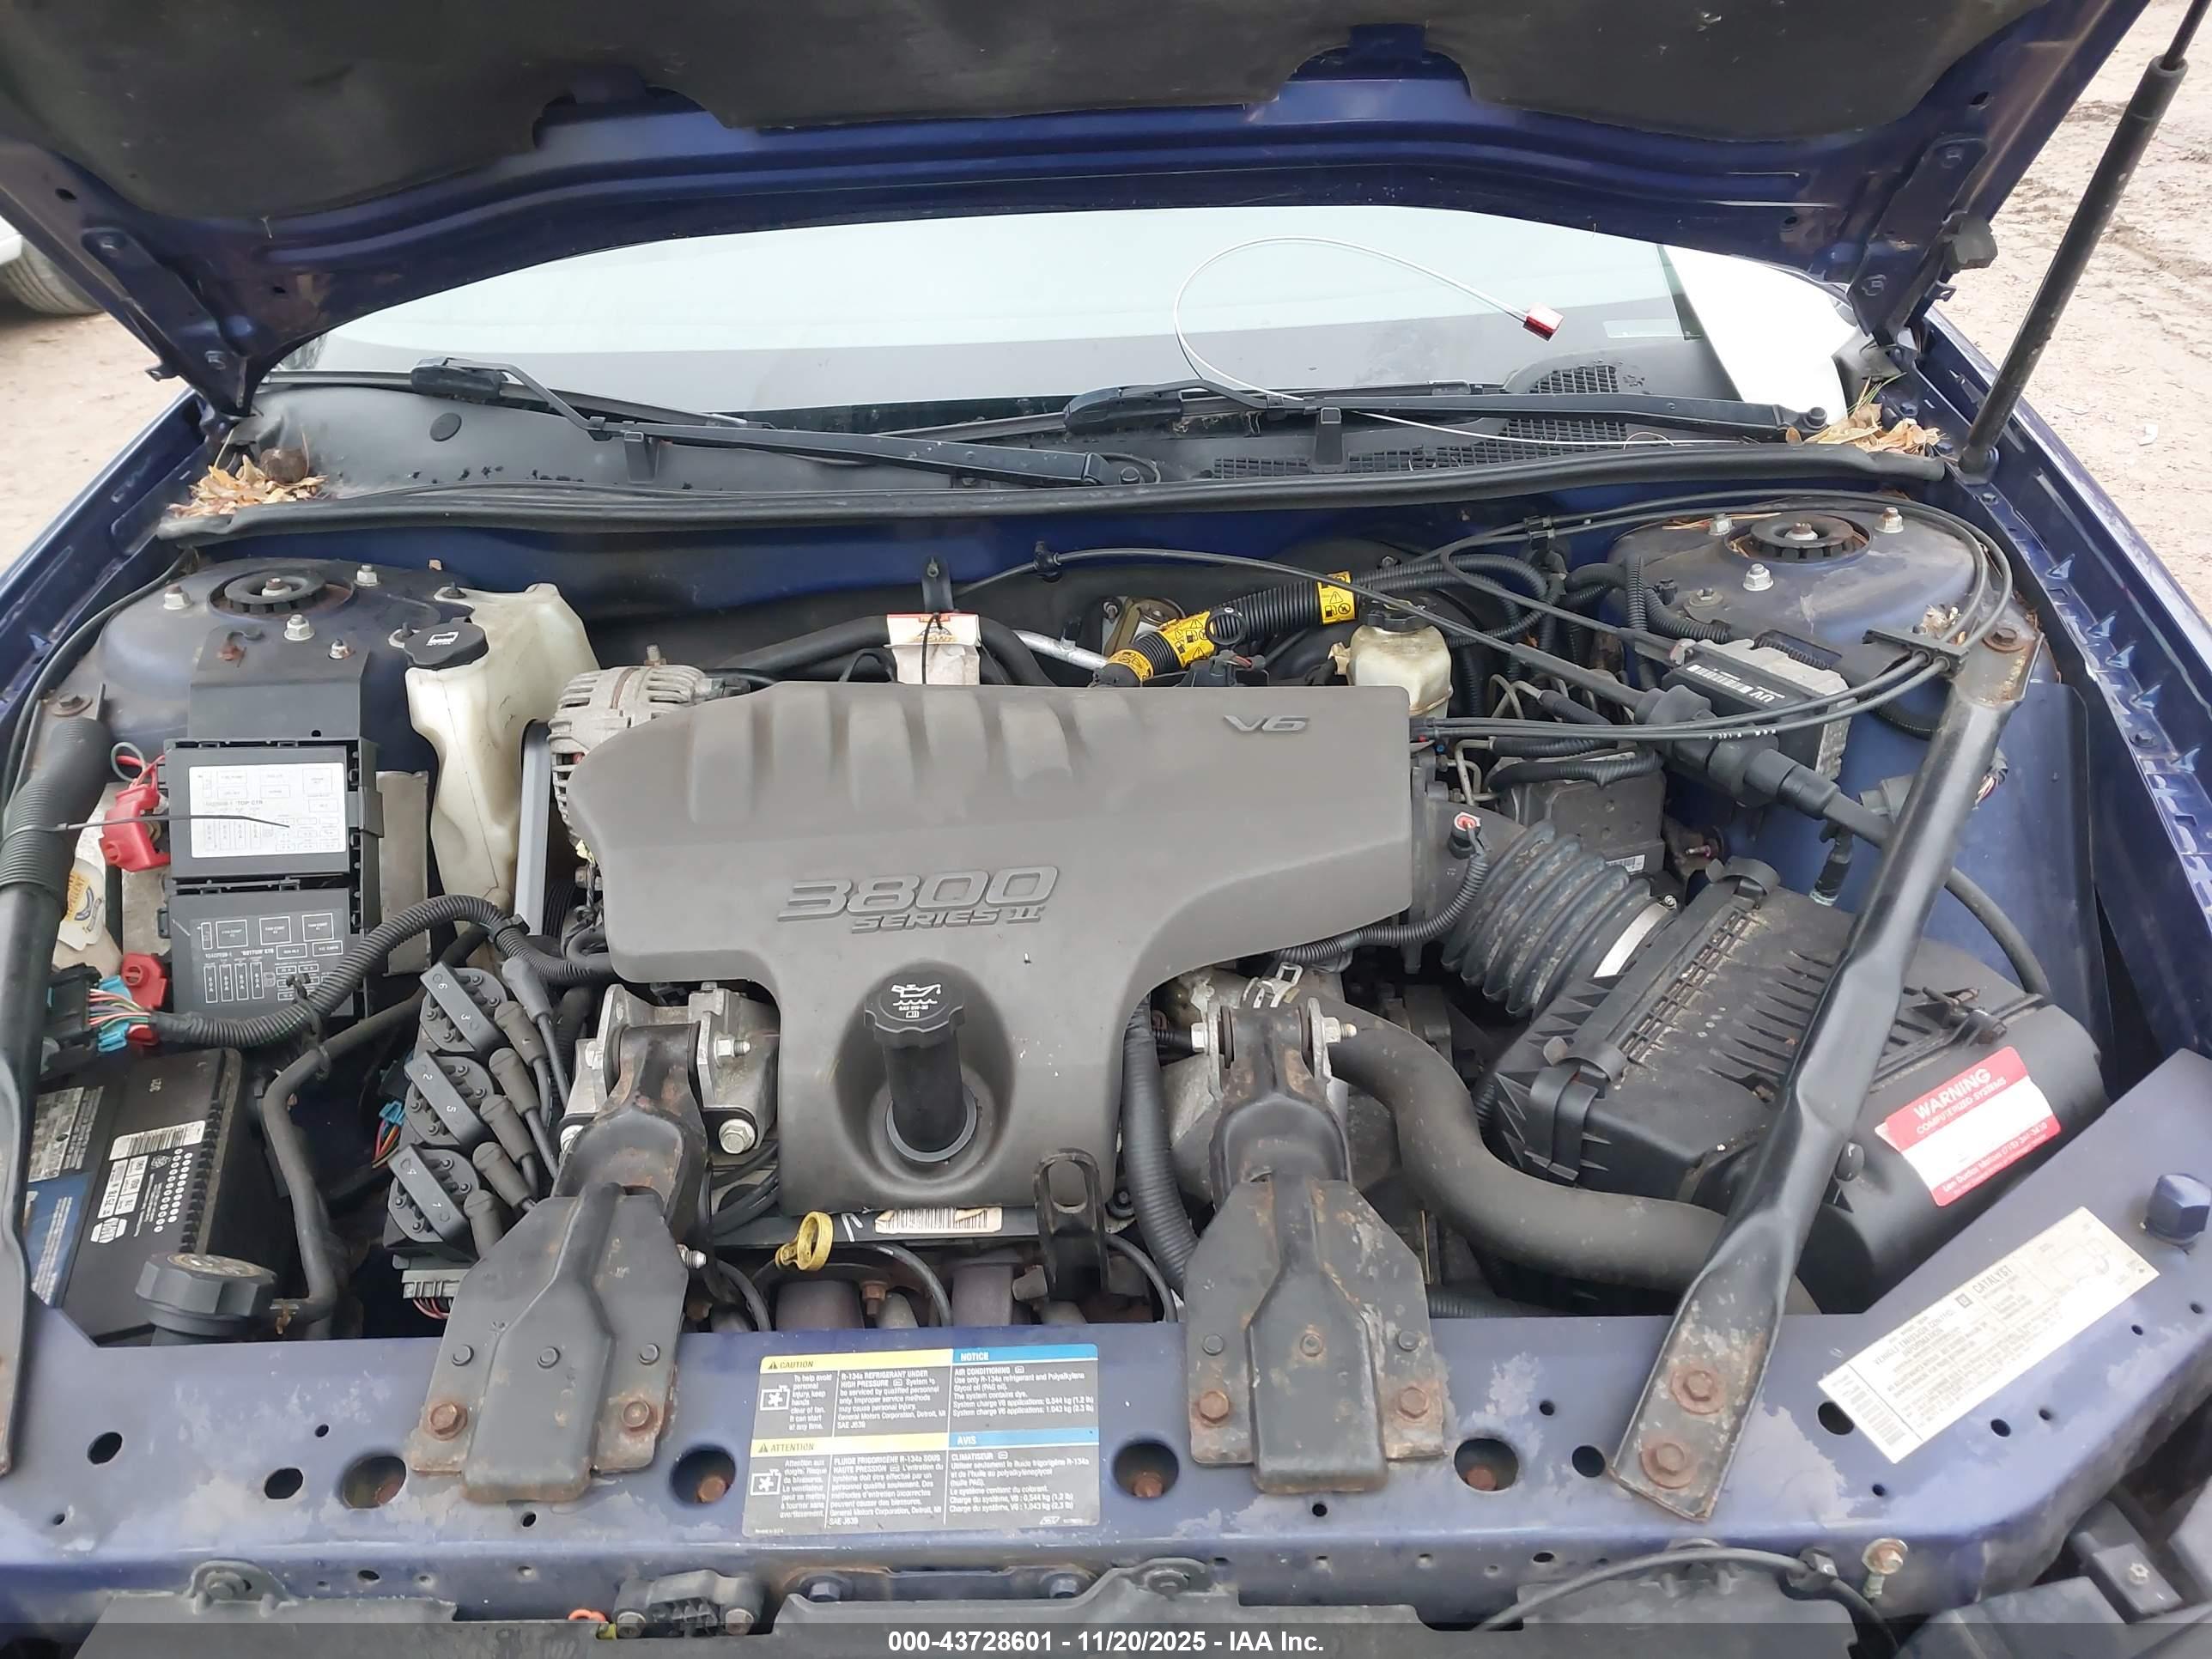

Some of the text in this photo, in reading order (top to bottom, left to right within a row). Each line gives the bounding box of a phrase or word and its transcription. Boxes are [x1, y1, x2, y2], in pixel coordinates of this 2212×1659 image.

[1223, 714, 1310, 732] V6
[777, 866, 1057, 921] 3800
[851, 908, 999, 933] SERIES
[1913, 1068, 1991, 1119] WARNING
[1972, 1265, 2013, 1294] CATALYST
[961, 1352, 988, 1361] NOTICE
[967, 1366, 1010, 1375] CONDITIONING
[802, 1374, 815, 1382] help
[1003, 1374, 1034, 1382] refrigerant
[841, 1380, 855, 1389] HIGH
[953, 1401, 975, 1409] System
[976, 1408, 997, 1417] charge
[957, 1436, 976, 1445] AVIS
[770, 1443, 814, 1452] ATTENTION
[951, 1452, 994, 1462] CLIMATISEUR
[834, 1466, 854, 1474] HAUTE
